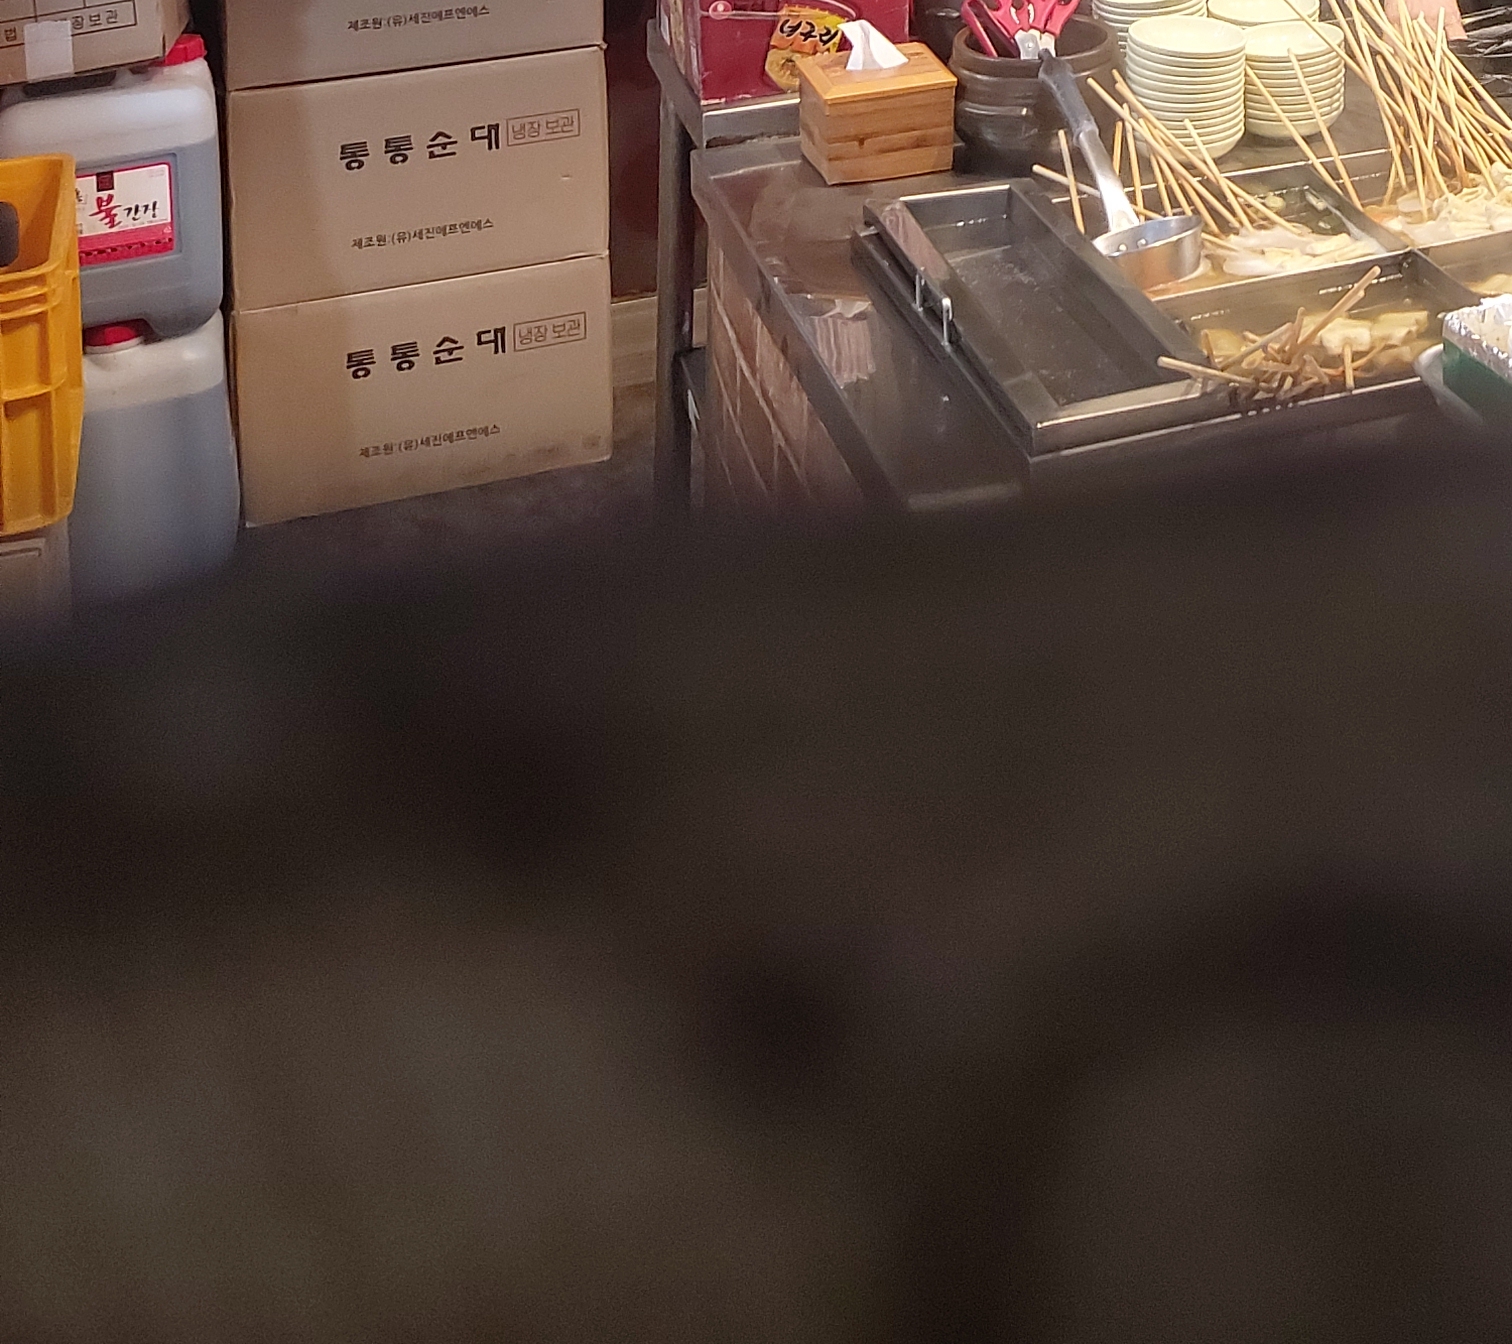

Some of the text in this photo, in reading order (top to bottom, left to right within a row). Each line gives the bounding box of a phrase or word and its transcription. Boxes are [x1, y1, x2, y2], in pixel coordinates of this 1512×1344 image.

[778, 18, 839, 47] 너구리
[339, 115, 575, 171] 통통순대 냉장 보관
[346, 320, 581, 379] 통통순대 냉장 보관
